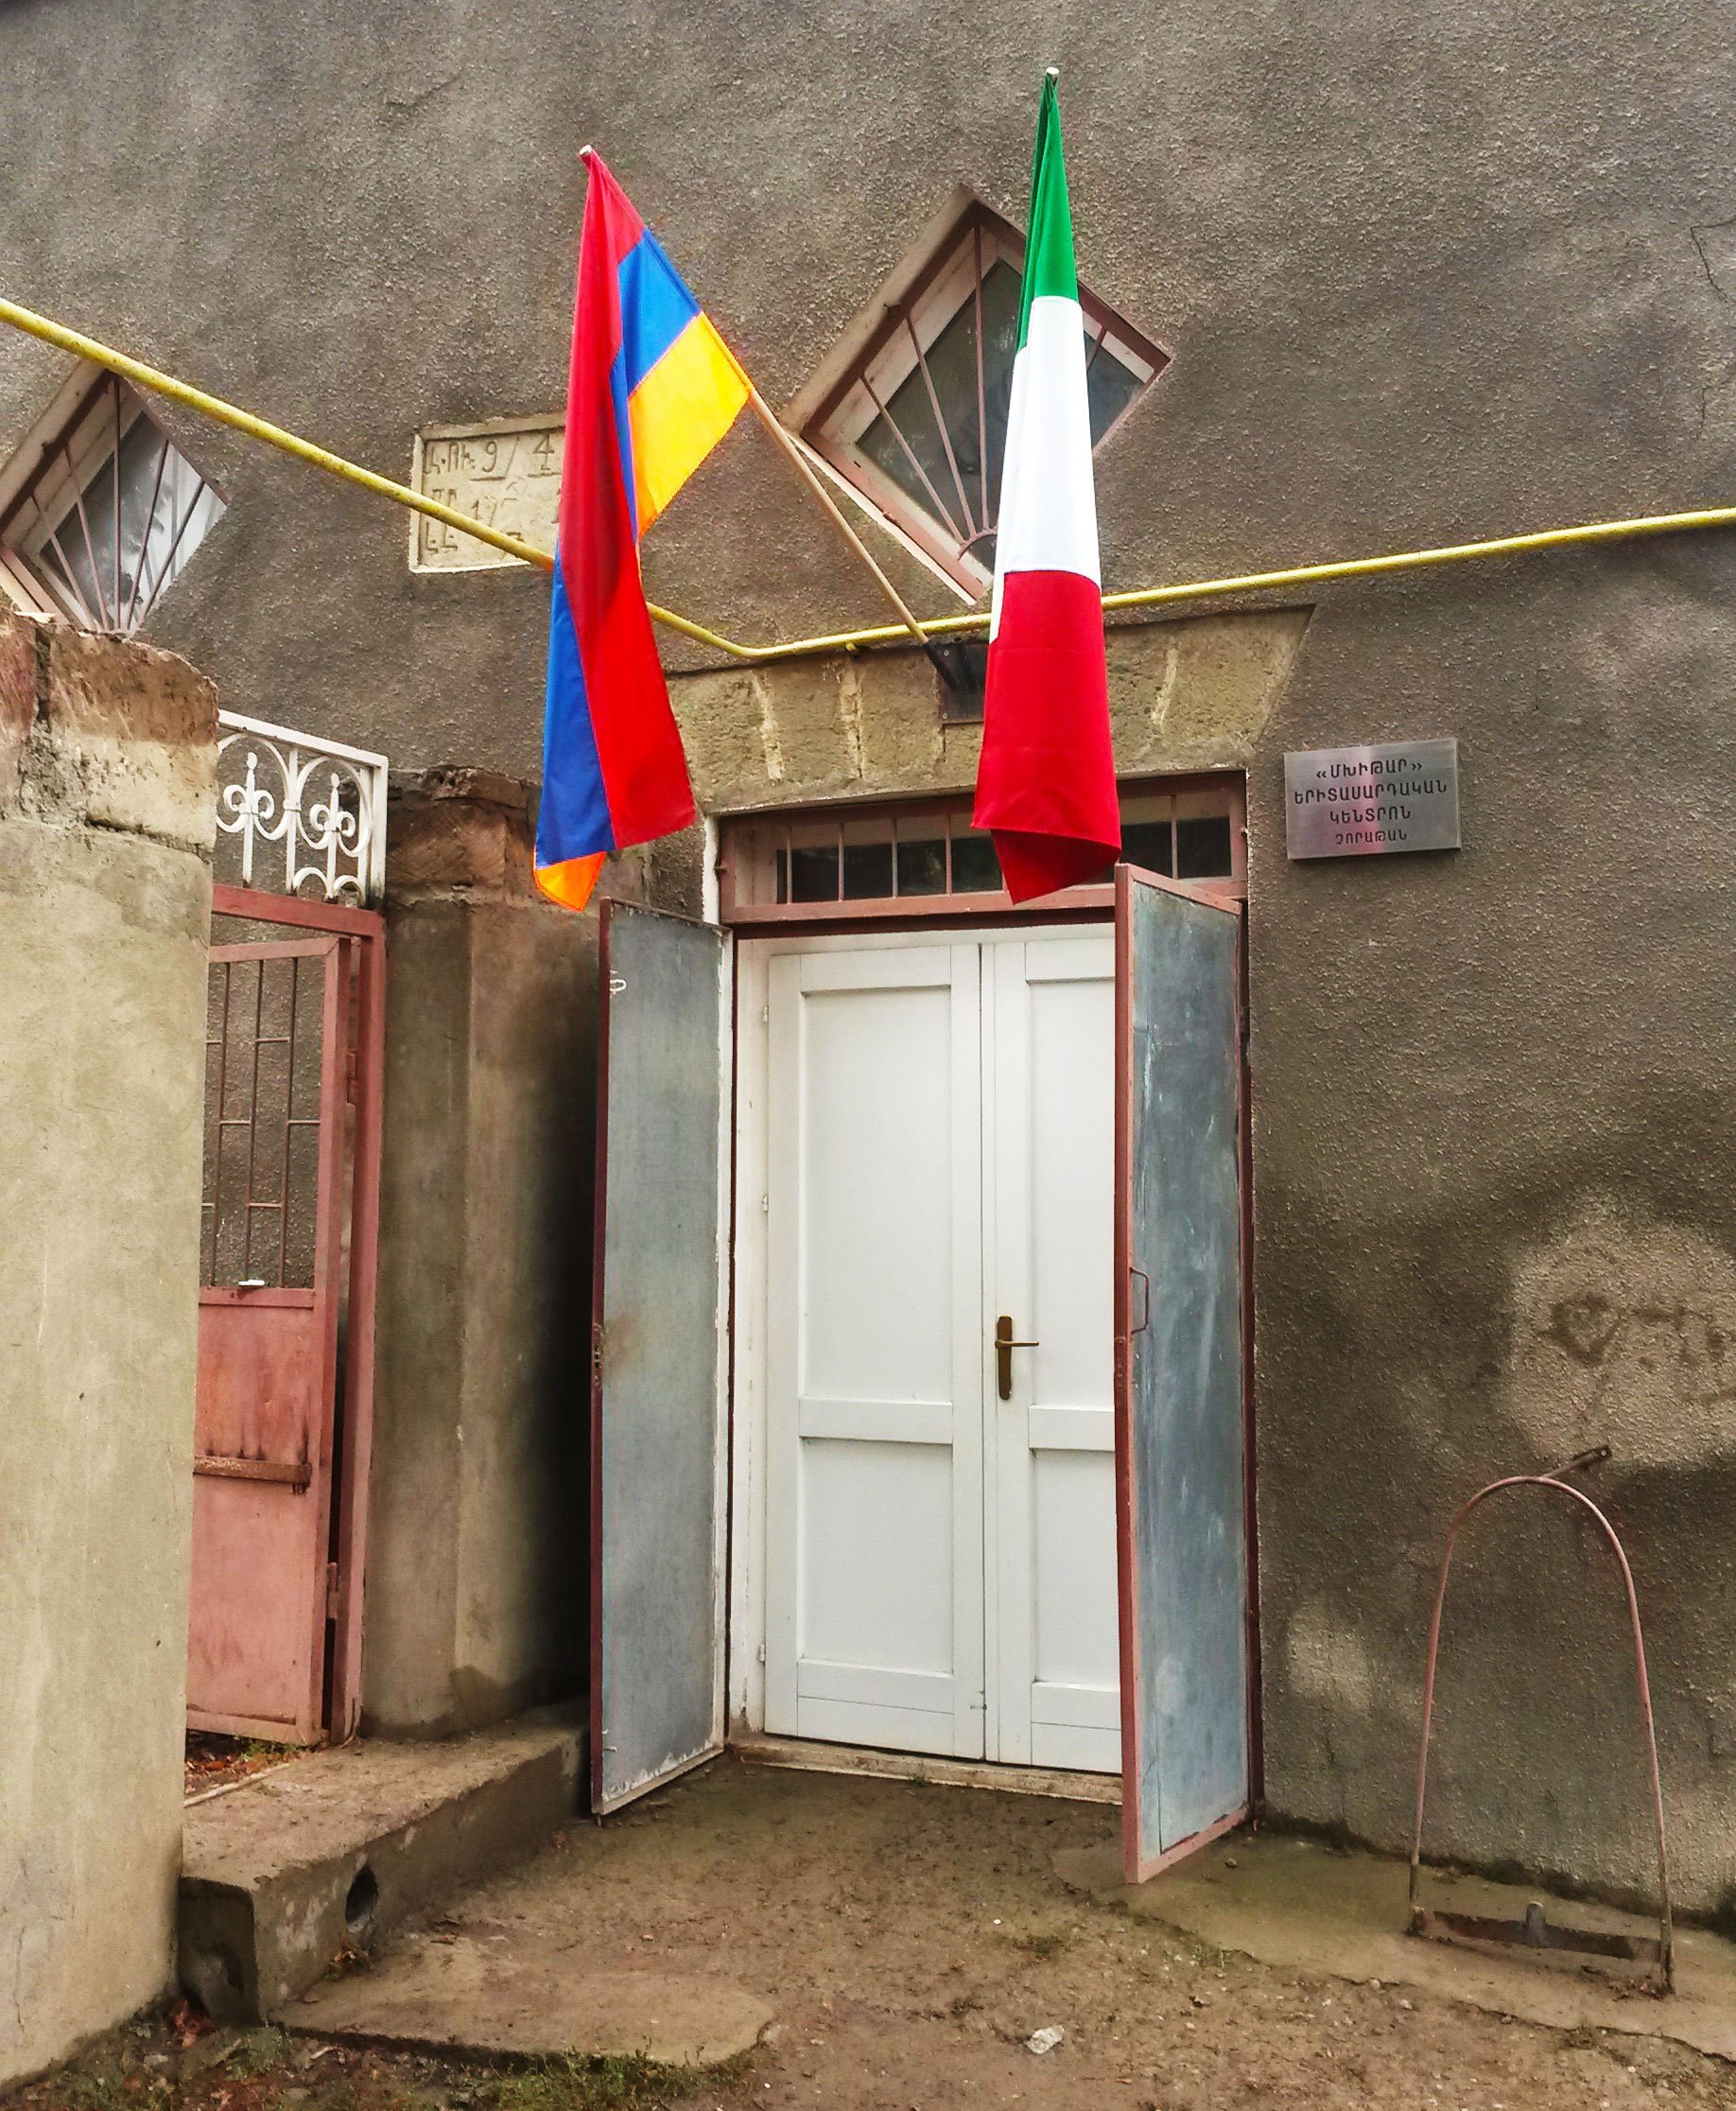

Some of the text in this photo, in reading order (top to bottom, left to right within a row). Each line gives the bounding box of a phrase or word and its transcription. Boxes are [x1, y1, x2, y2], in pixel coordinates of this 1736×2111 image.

[1316, 758, 1423, 779] «ՄԽԻԹԱՐ»
[1293, 779, 1448, 805] ԵՐԻՏԱՍԱՐԴԱԿԱՆ
[1329, 806, 1412, 825] ԿԵՆՏՐՈՆ
[1334, 829, 1408, 846] ՉՈՐԱԹԱՆ
